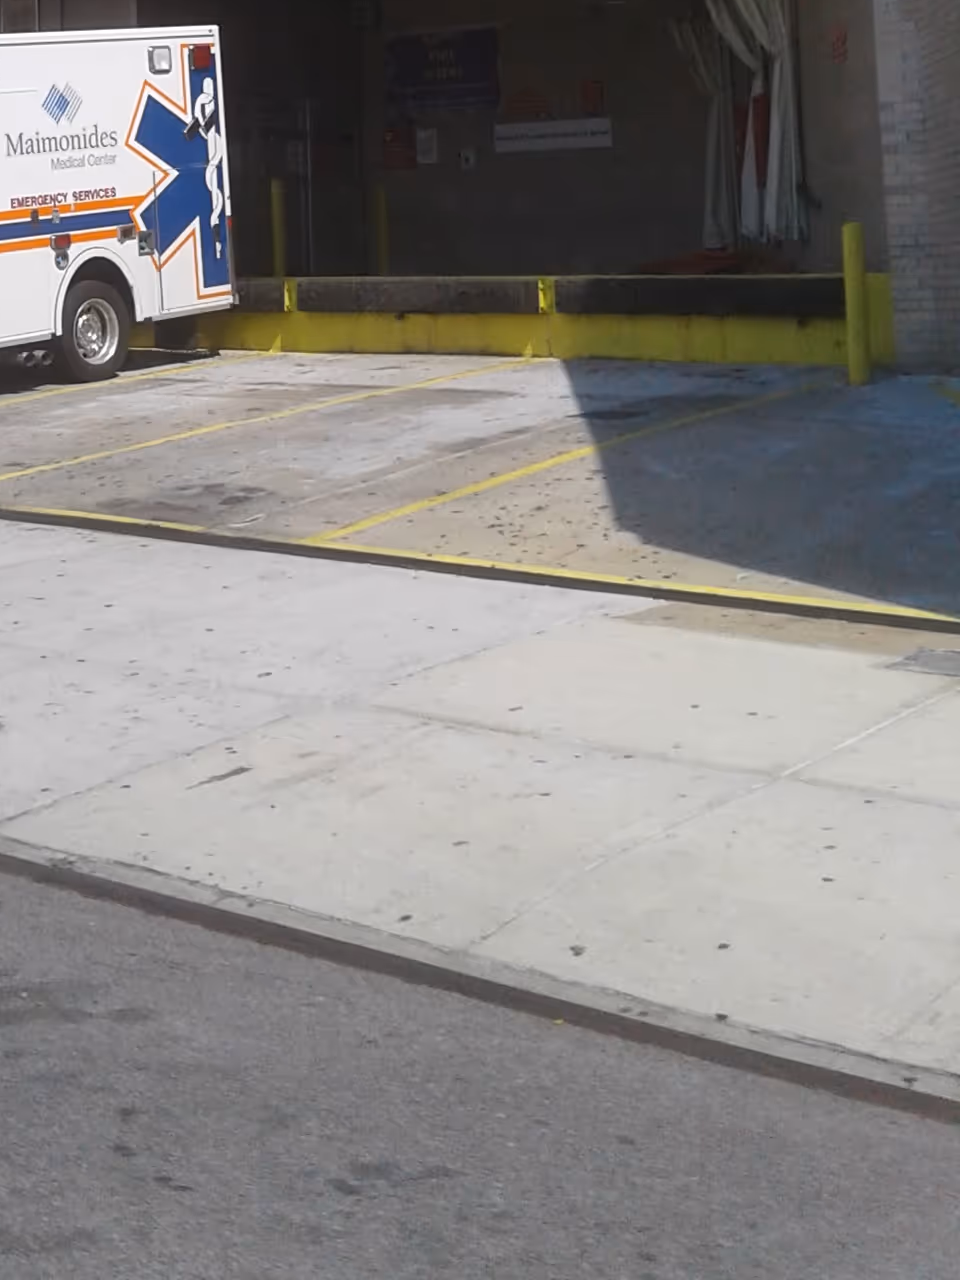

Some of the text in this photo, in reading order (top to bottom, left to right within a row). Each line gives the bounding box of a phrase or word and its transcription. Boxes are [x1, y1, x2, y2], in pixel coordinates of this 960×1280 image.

[4, 123, 118, 157] Maimonides
[50, 152, 117, 170] Medical Center
[10, 187, 117, 209] EMERGENCY SERVICES
